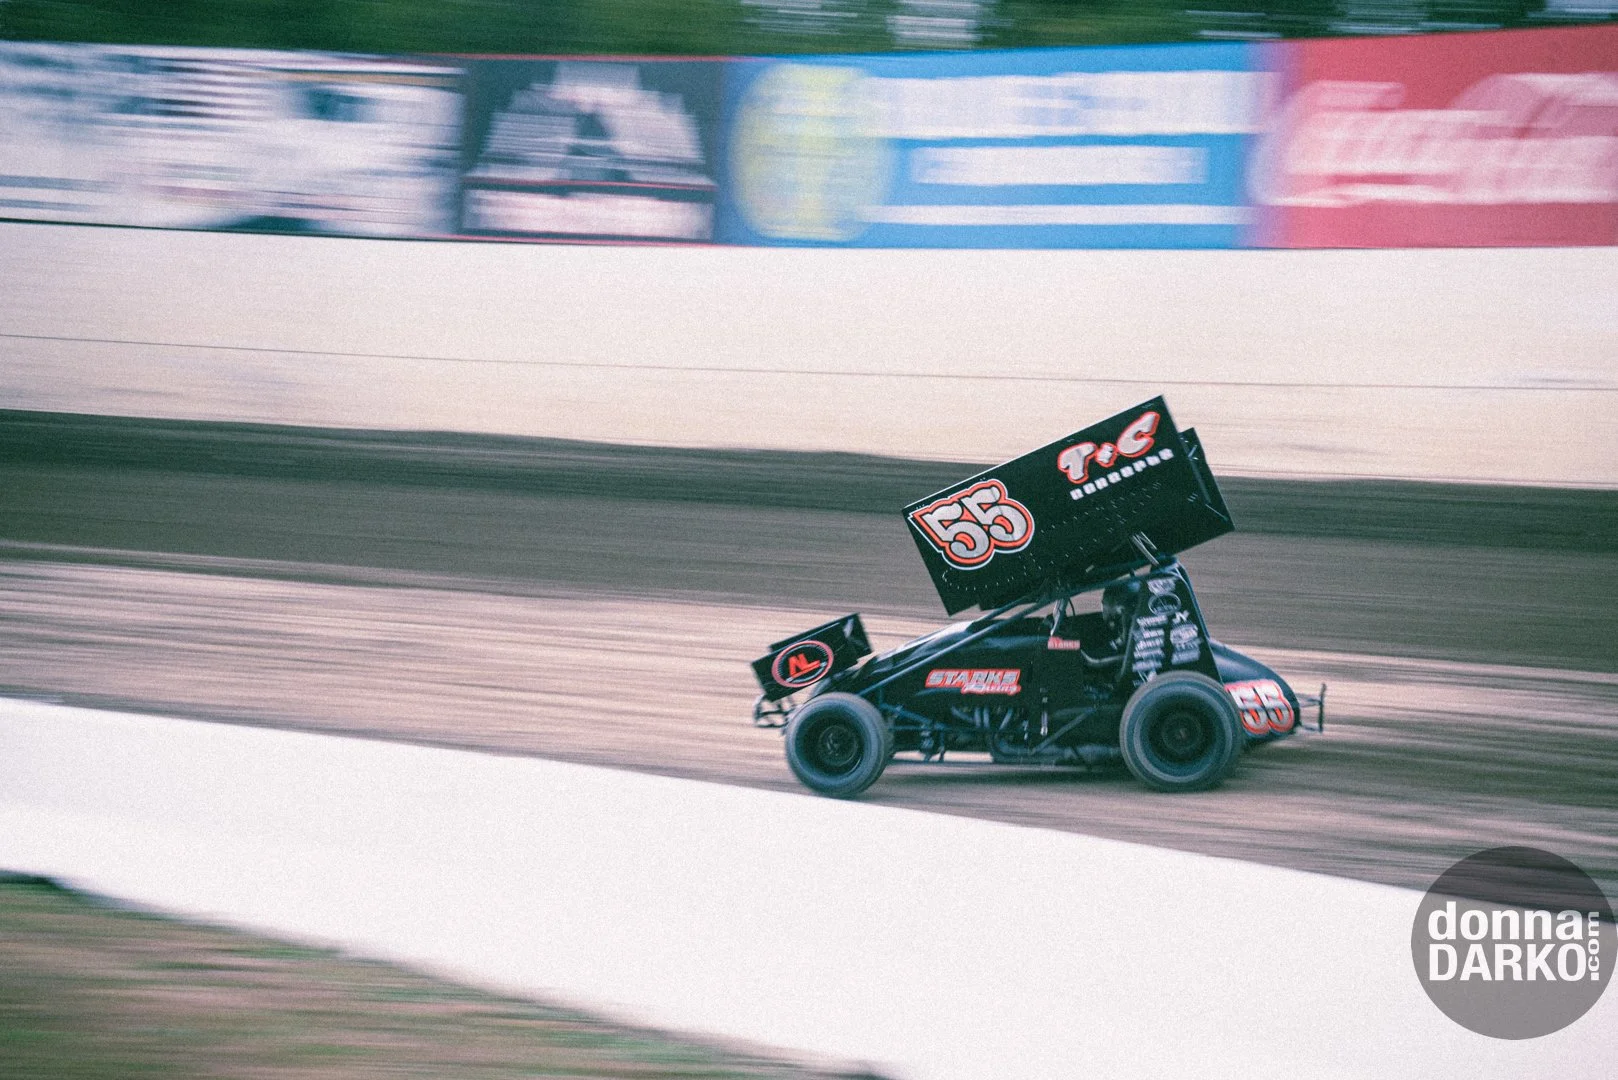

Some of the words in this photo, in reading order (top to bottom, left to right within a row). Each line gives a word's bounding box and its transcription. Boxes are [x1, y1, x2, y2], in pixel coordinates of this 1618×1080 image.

[909, 479, 1034, 568] 55
[926, 669, 1020, 687] STARKS
[1224, 679, 1294, 734] 55
